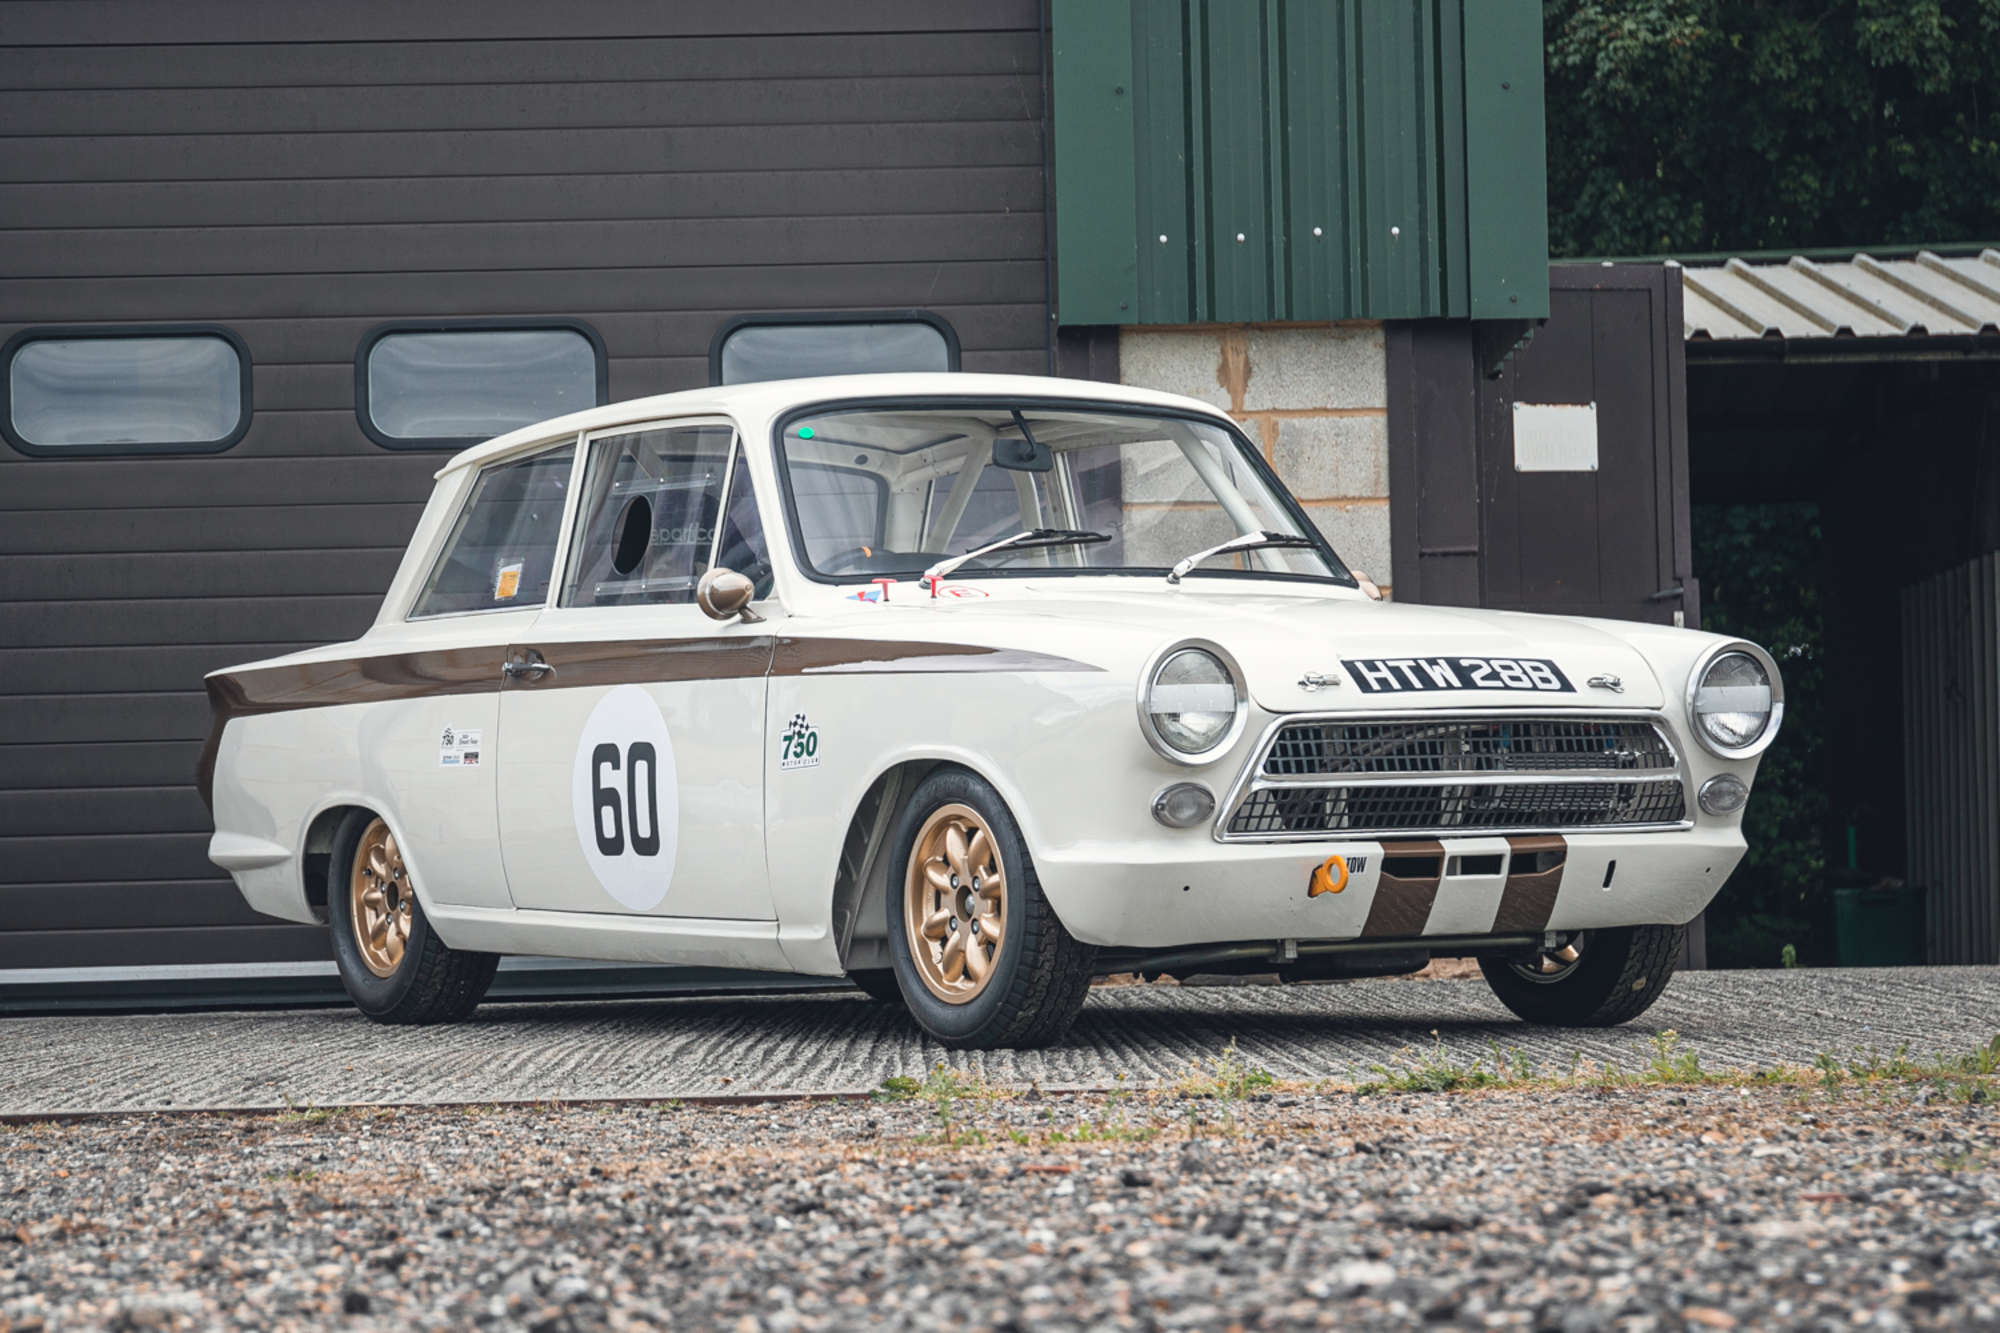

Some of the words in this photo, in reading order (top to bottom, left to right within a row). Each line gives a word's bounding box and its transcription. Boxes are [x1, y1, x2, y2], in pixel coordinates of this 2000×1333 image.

[1354, 658, 1463, 690] HTW
[1458, 658, 1562, 690] 28B
[783, 731, 818, 760] 750
[592, 742, 660, 856] 60
[1346, 856, 1368, 874] TOW
